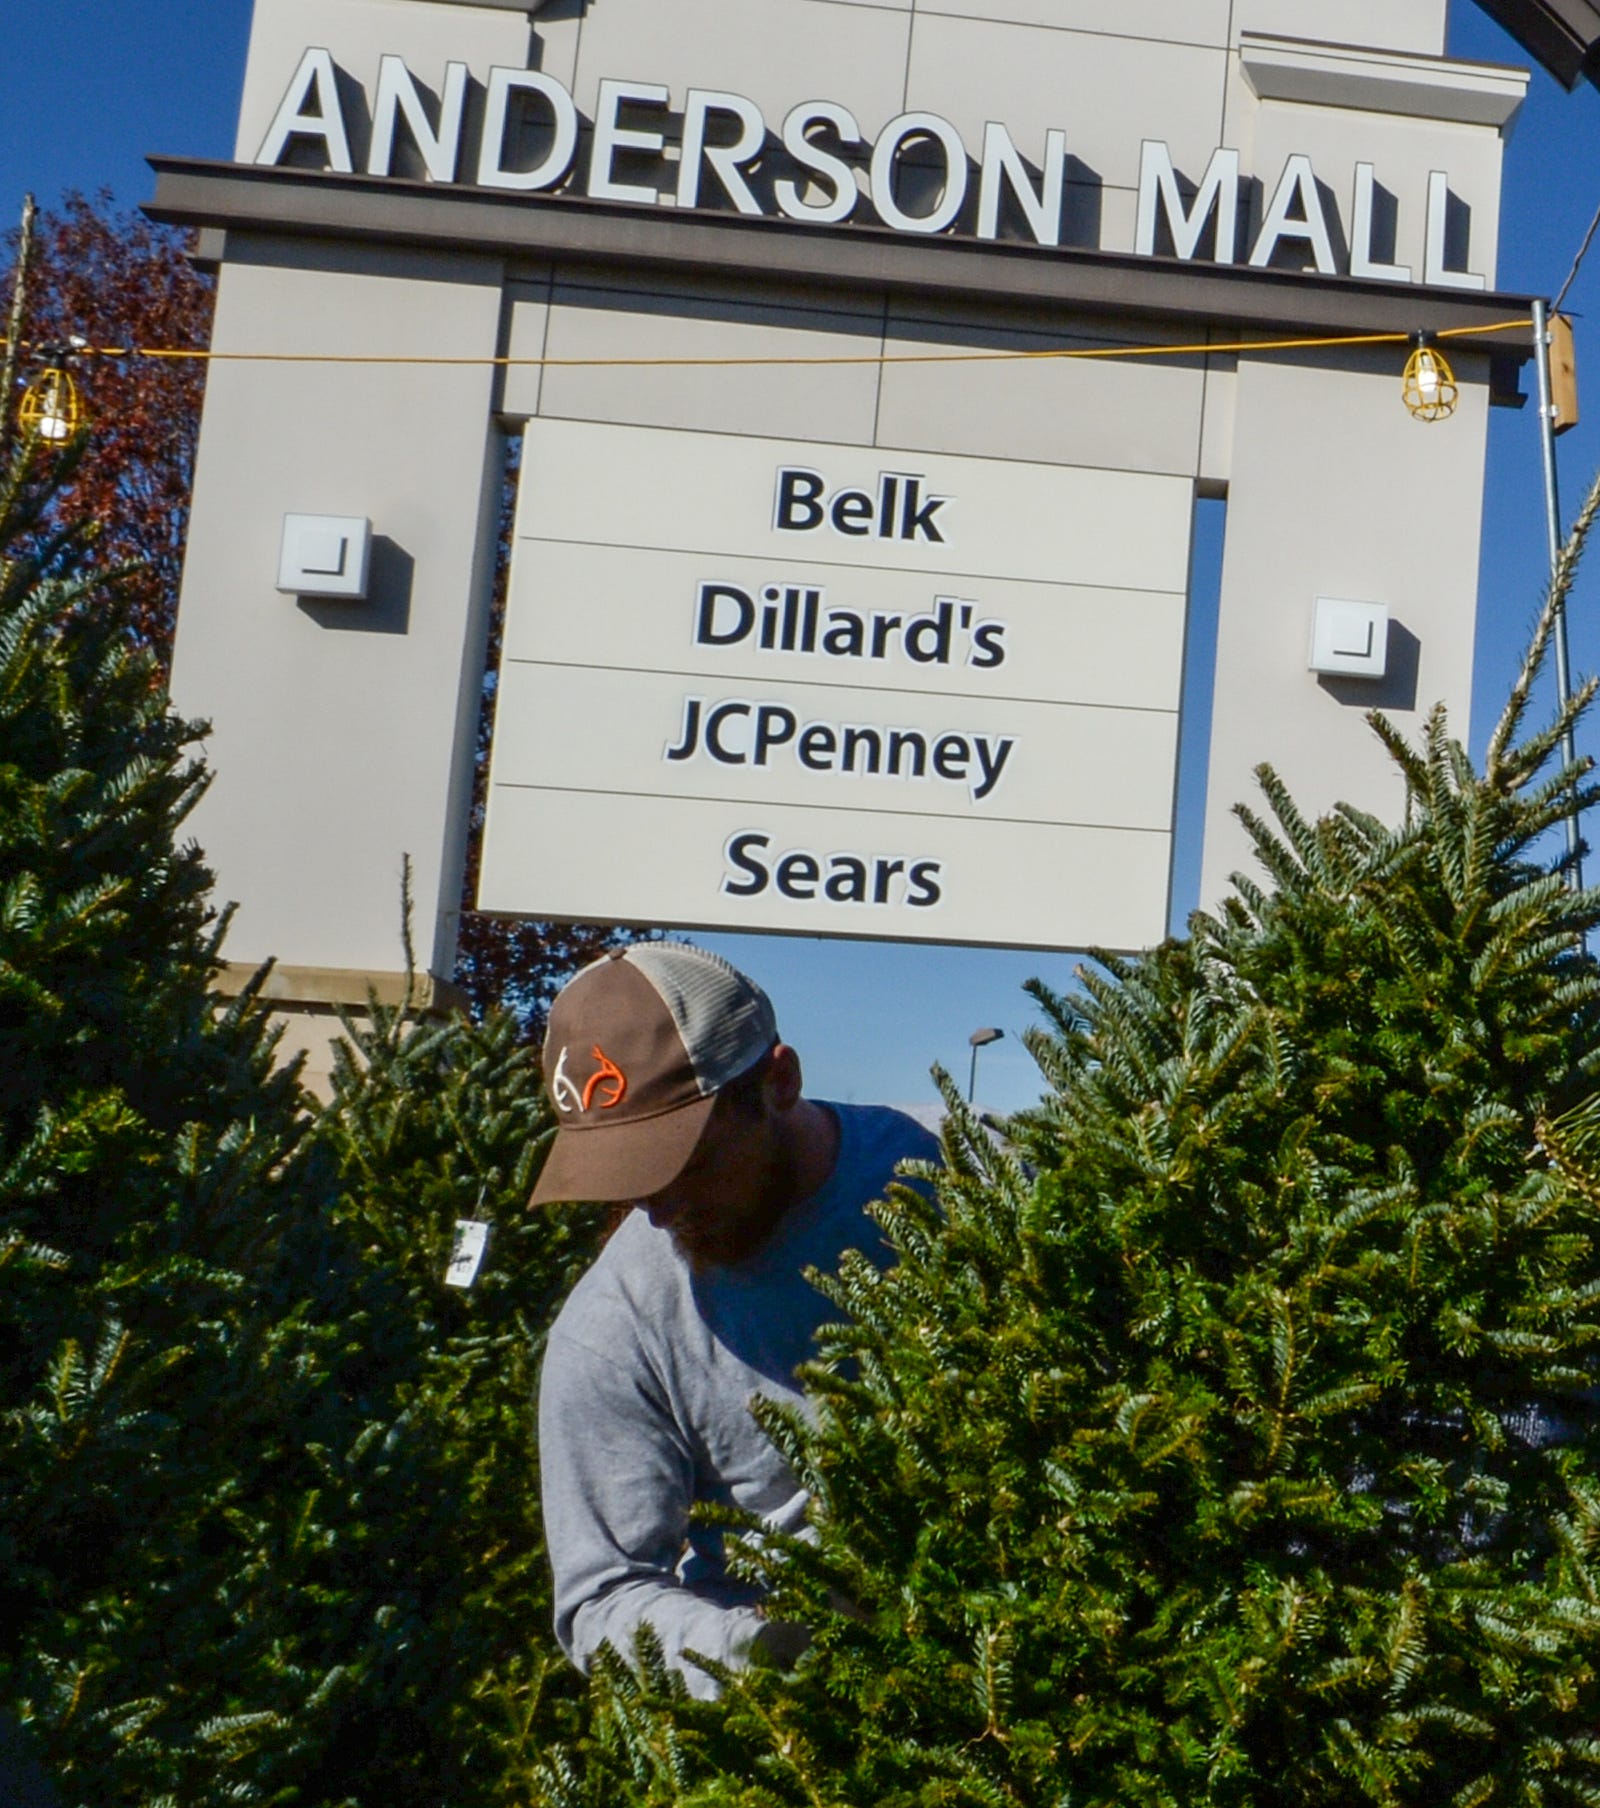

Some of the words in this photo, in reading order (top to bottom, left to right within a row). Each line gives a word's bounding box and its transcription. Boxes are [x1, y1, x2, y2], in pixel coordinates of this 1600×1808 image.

[254, 47, 1066, 247] ANDERSON
[1134, 139, 1486, 291] MALL
[776, 470, 947, 543] Belk
[696, 583, 1006, 668] Dillard's
[666, 699, 1015, 801] JCPenney
[724, 832, 942, 907] Sears
